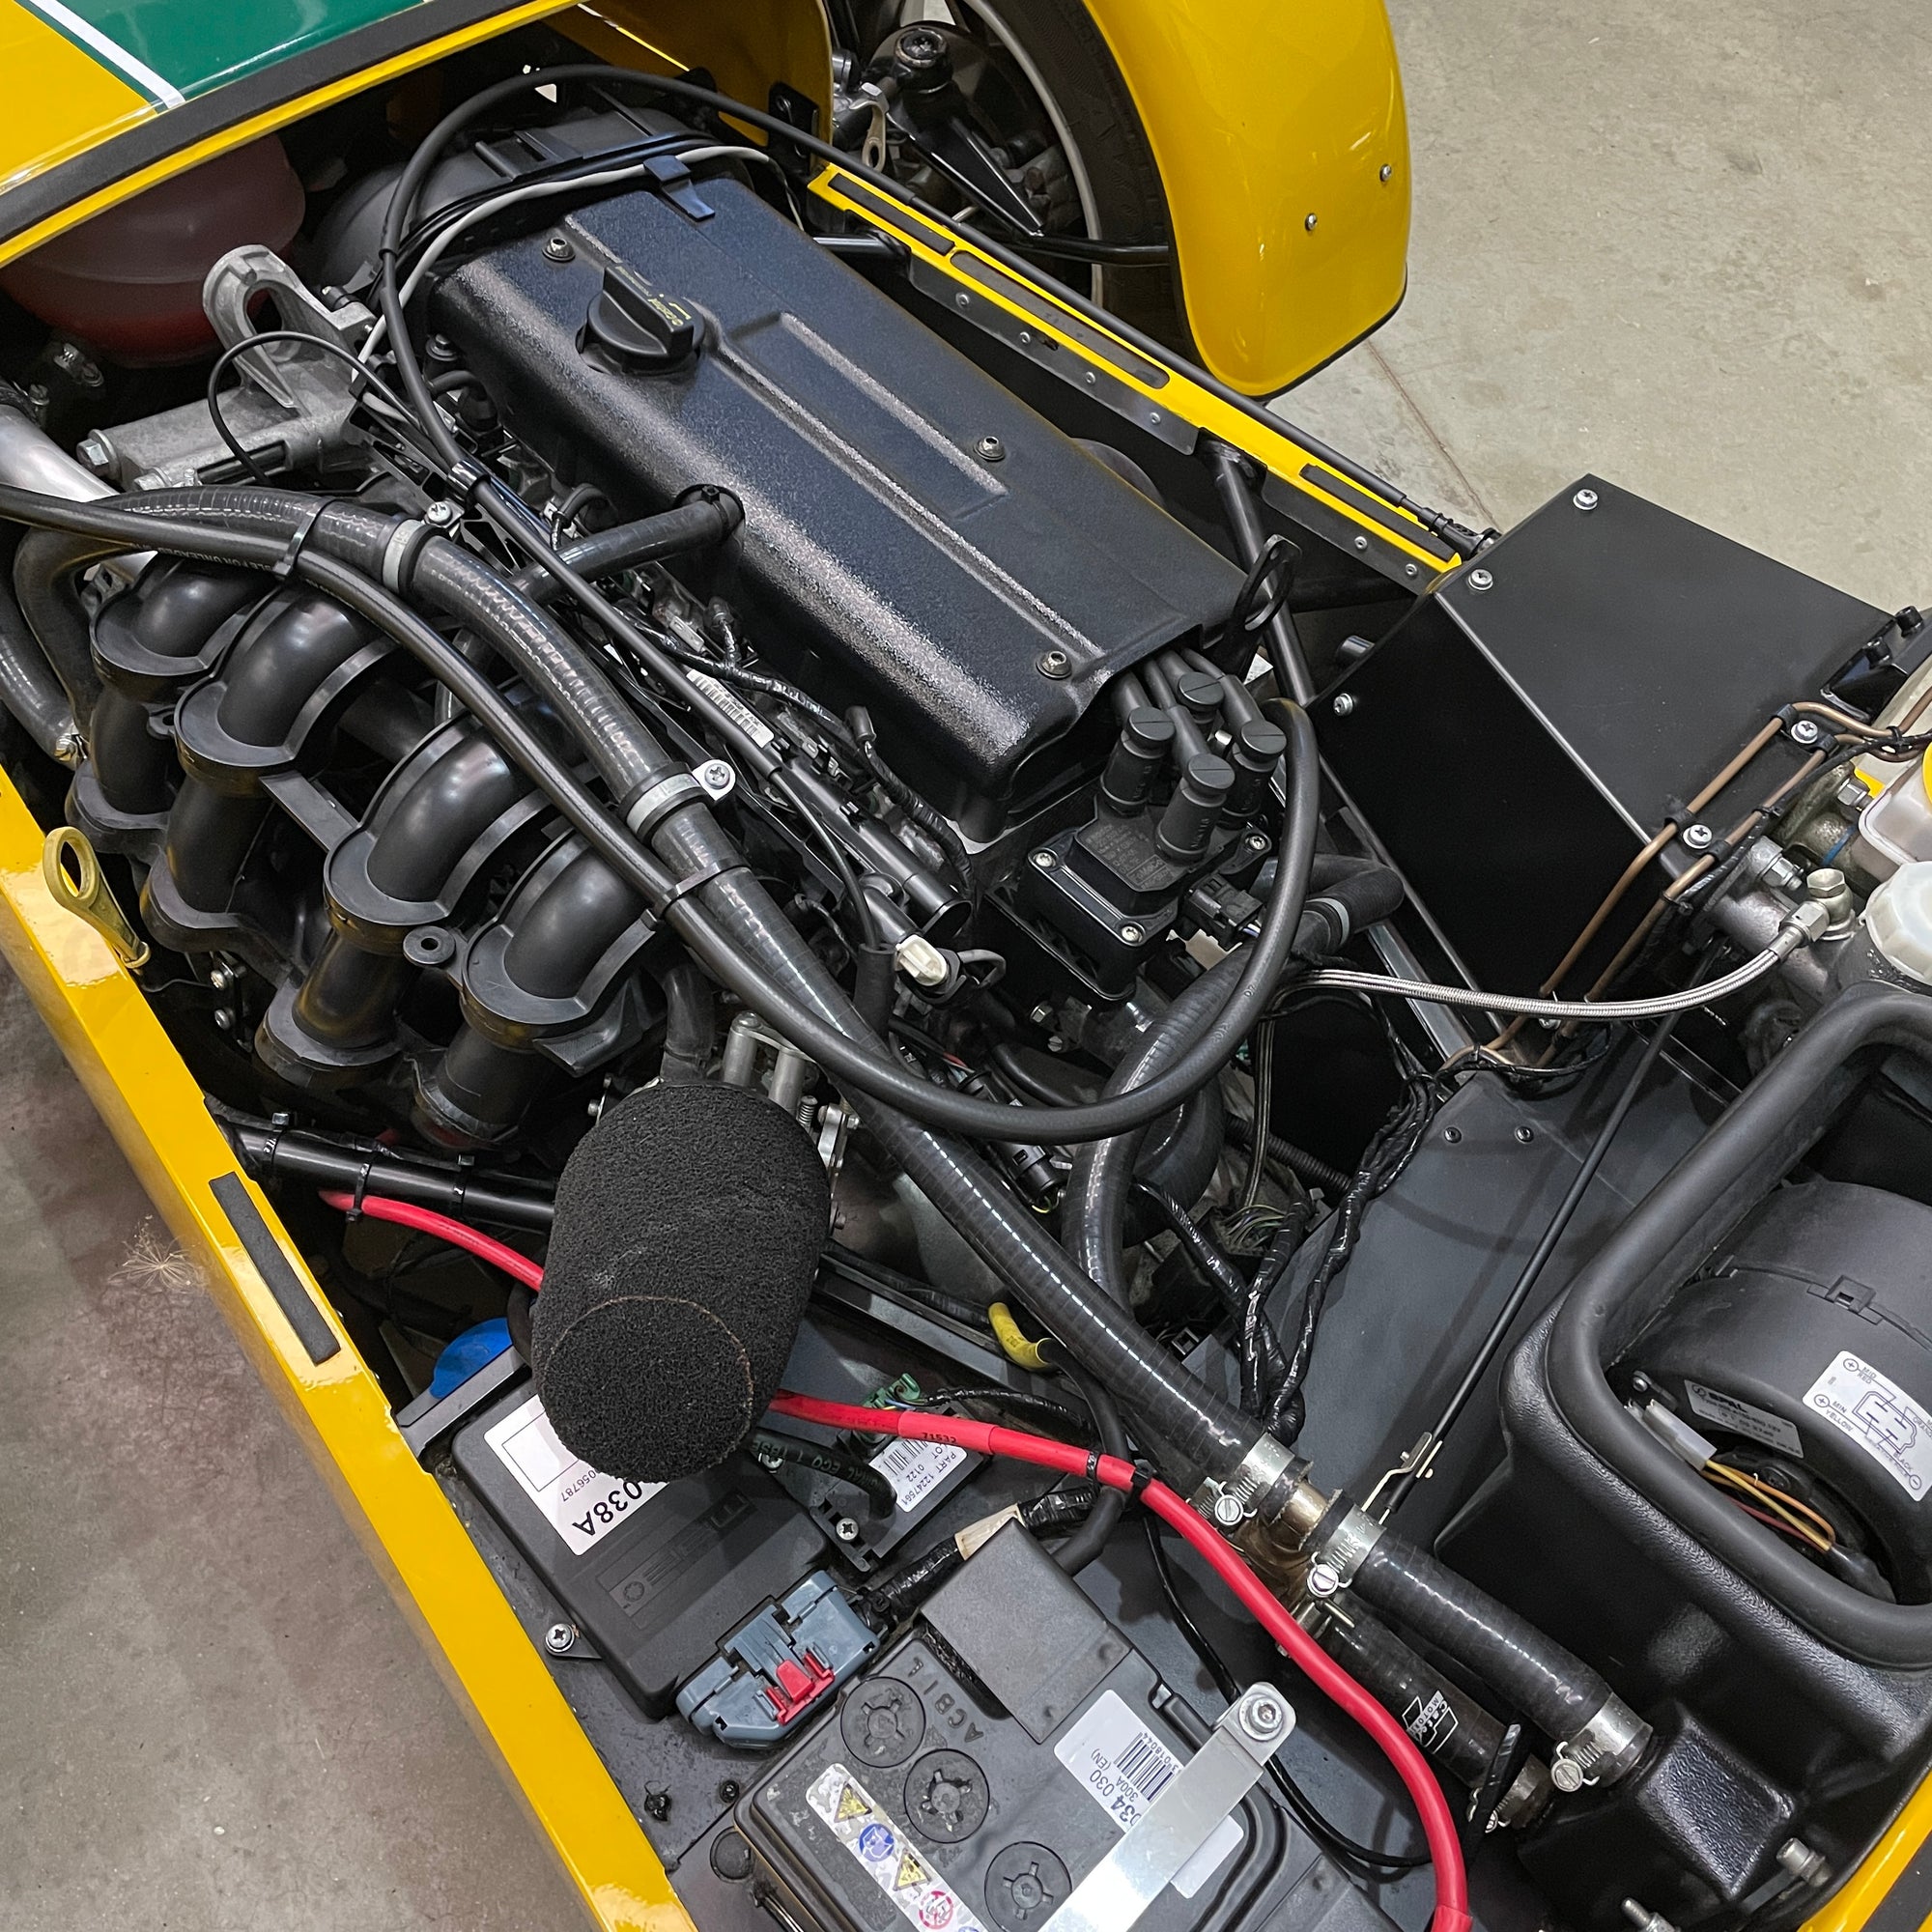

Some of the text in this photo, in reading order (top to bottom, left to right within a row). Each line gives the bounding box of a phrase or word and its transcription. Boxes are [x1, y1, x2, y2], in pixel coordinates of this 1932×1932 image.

[1832, 1401, 1847, 1413] MIN
[906, 1443, 948, 1482] OT 0122
[935, 1451, 956, 1473] PART
[561, 1468, 598, 1501] 056787
[1091, 1748, 1112, 1771] (EN)
[1090, 1769, 1115, 1797] 030
[1116, 1776, 1138, 1802] 300A
